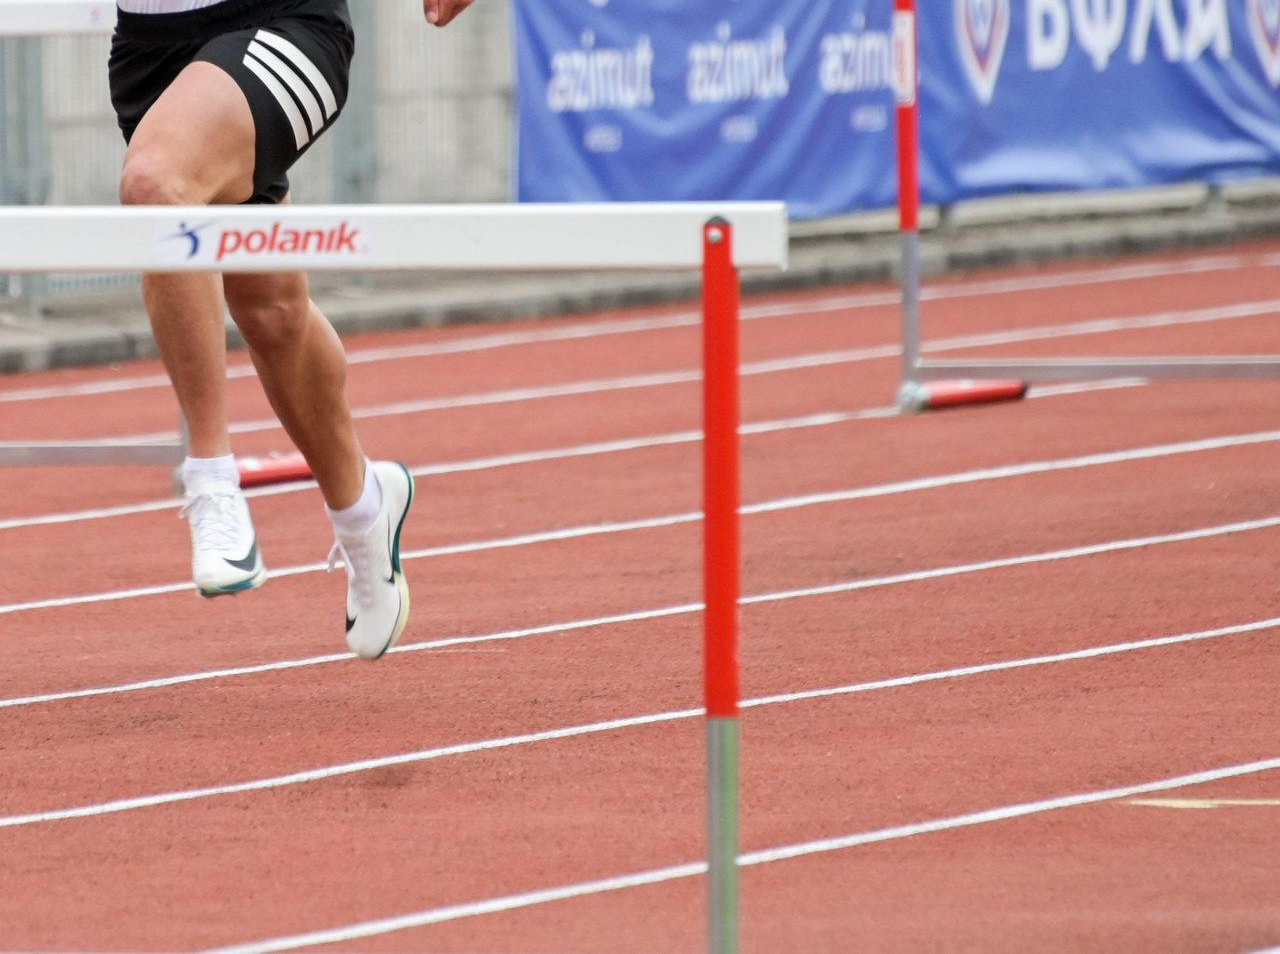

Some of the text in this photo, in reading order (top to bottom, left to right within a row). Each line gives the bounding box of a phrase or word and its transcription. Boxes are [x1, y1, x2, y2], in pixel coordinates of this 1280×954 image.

[547, 28, 655, 113] azimut
[686, 19, 790, 106] azimut
[819, 10, 894, 95] azim
[215, 221, 361, 263] polanik
